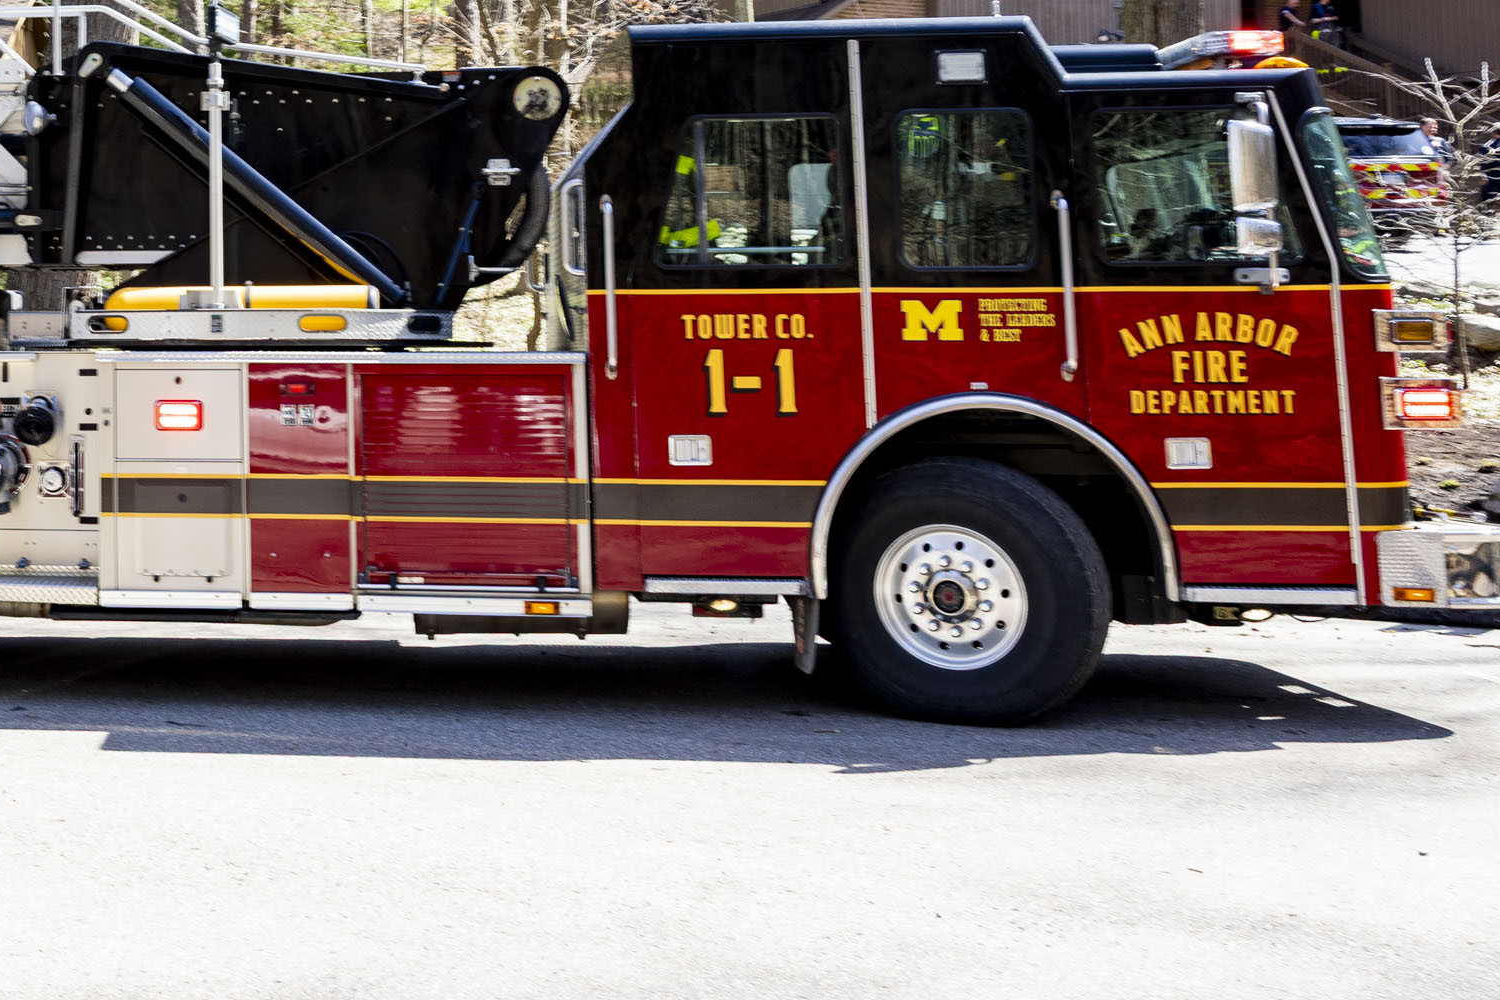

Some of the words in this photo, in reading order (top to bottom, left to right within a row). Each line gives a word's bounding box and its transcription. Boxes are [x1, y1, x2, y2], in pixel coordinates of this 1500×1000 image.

[978, 298, 1047, 312] PROTECTING
[680, 314, 769, 339] TOWER
[775, 313, 814, 339] CO.
[900, 300, 964, 341] M
[978, 313, 1003, 327] THE
[1005, 313, 1056, 327] LEADERS
[980, 328, 990, 342] &
[993, 328, 1022, 342] BEST
[1118, 314, 1185, 358] ANN
[1195, 312, 1299, 356] ARBOR
[1171, 350, 1249, 384] FIRE
[702, 348, 798, 418] 1-1
[1129, 390, 1296, 415] DEPARTMENT
